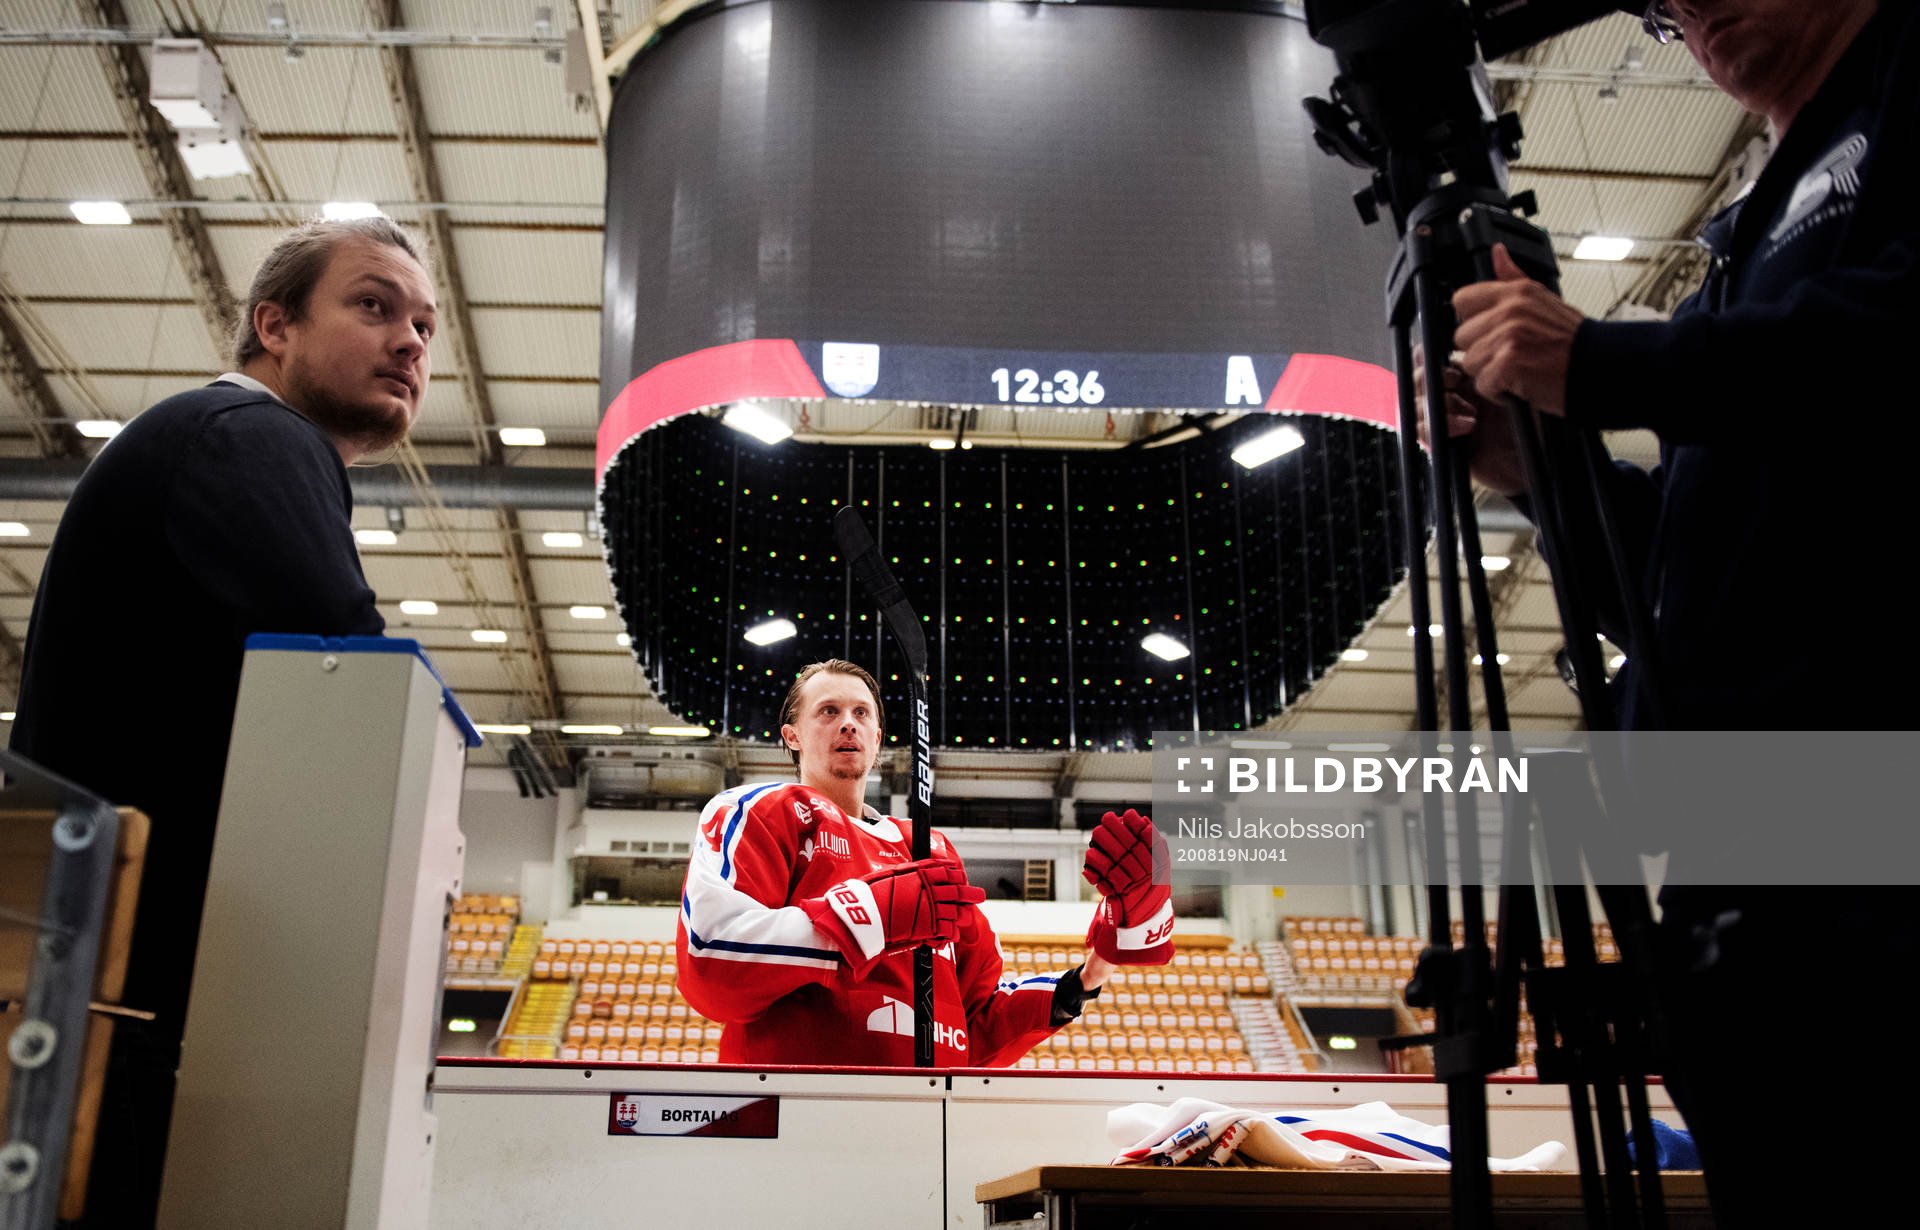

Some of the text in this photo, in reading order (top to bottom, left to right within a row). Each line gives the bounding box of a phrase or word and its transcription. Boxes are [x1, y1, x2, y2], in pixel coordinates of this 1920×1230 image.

[991, 368, 1105, 404] 12:36
[1225, 355, 1262, 405] A
[917, 699, 930, 807] BAUER
[661, 1109, 739, 1123] BORTALAG
